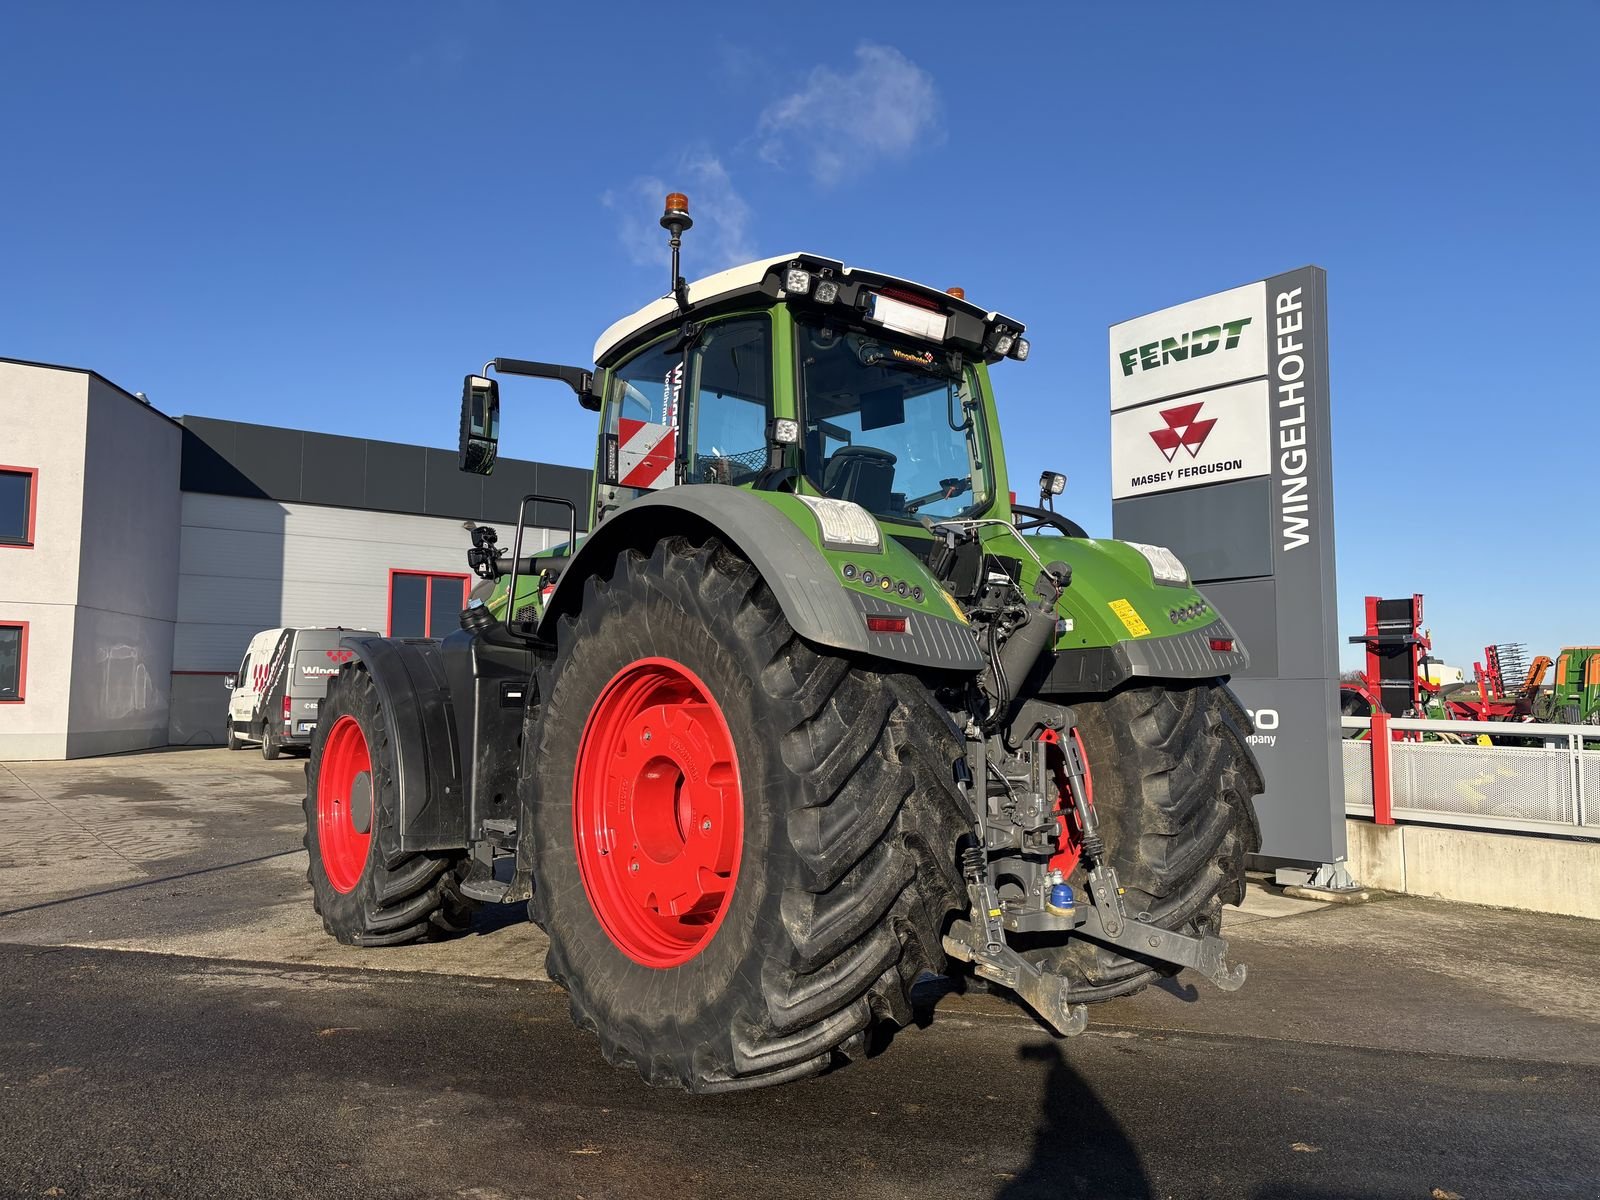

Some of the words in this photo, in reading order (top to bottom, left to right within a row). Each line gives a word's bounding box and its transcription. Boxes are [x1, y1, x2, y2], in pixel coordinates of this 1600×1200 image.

[1119, 317, 1253, 377] FENDT
[1276, 286, 1309, 552] WINGELHOFER
[1131, 470, 1174, 488] MASSEY
[1178, 459, 1243, 479] FERGUSON
